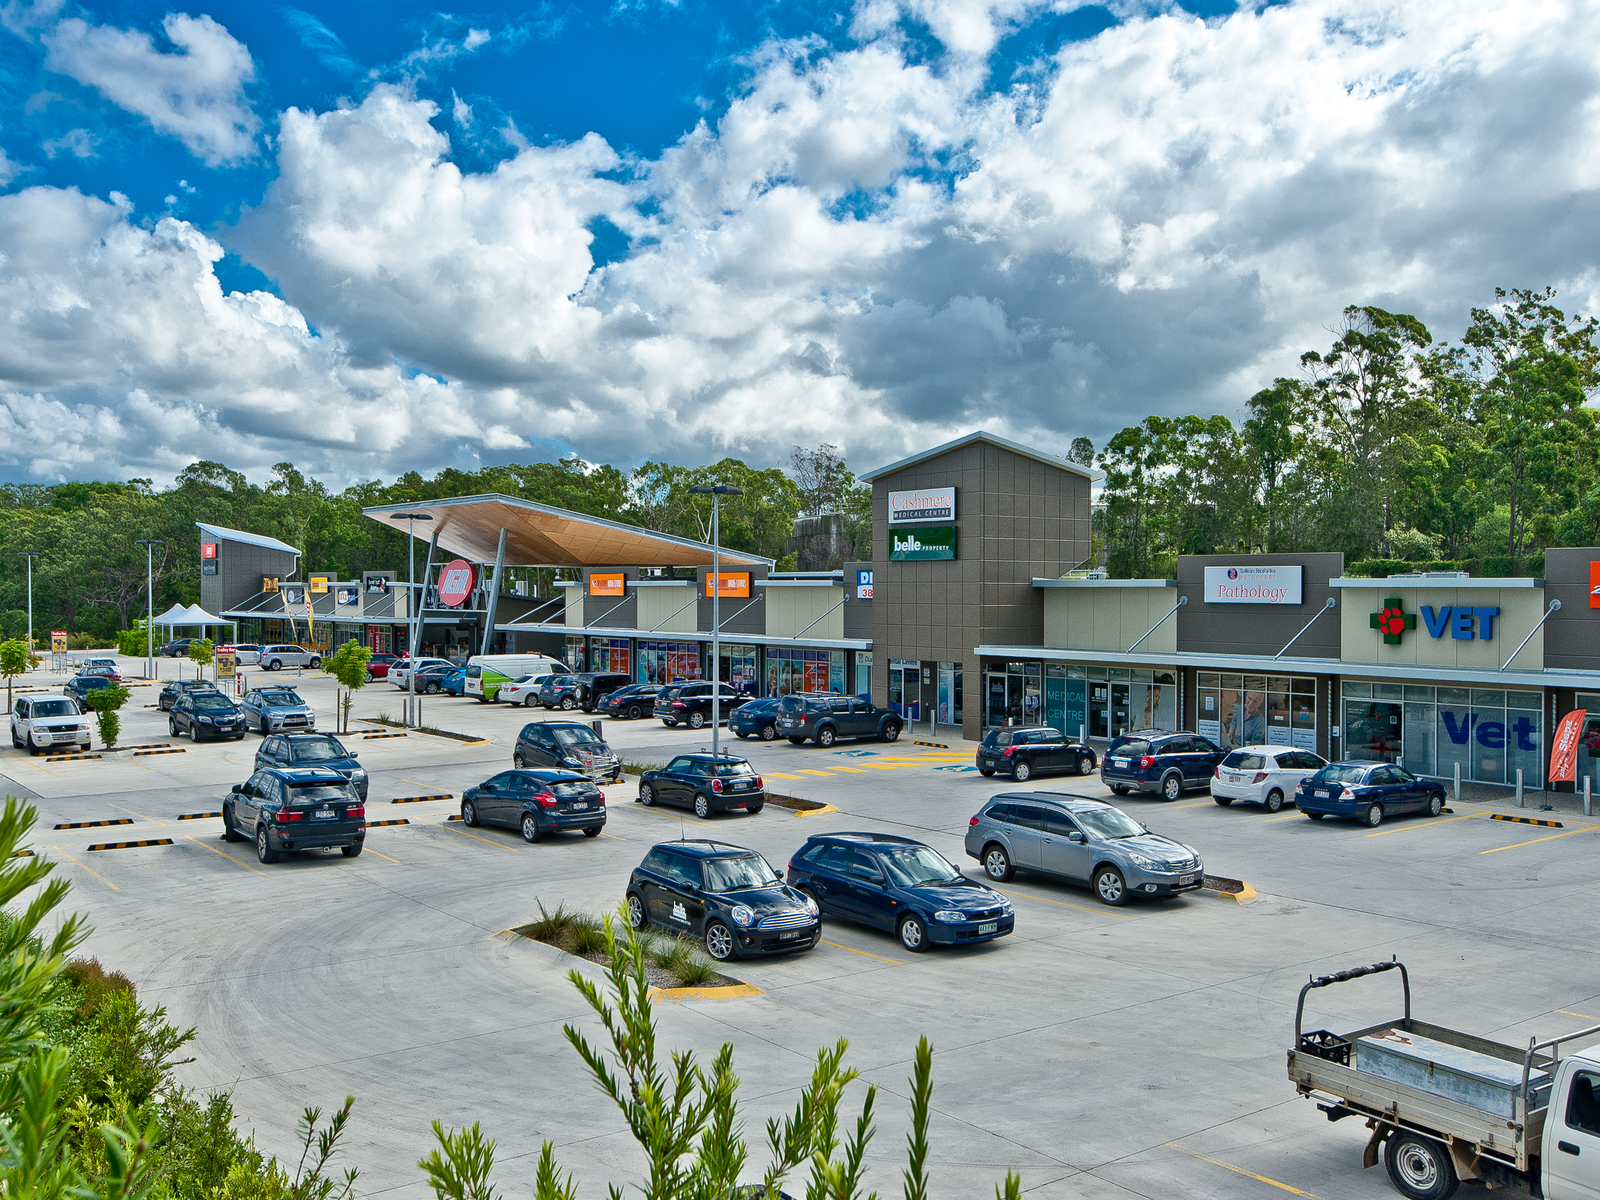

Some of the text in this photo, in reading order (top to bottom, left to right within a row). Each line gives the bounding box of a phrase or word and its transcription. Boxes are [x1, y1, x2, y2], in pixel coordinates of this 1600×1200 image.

[892, 493, 951, 511] Cashmere
[925, 509, 950, 517] CENTRE
[894, 535, 921, 551] belle
[441, 569, 470, 595] IGA
[1218, 585, 1288, 602] Pathology
[1420, 606, 1500, 640] VET
[1048, 691, 1086, 703] MEDICAL
[1048, 708, 1084, 721] CENTRE
[1440, 711, 1537, 751] Vet
[1558, 720, 1573, 752] Stepz
